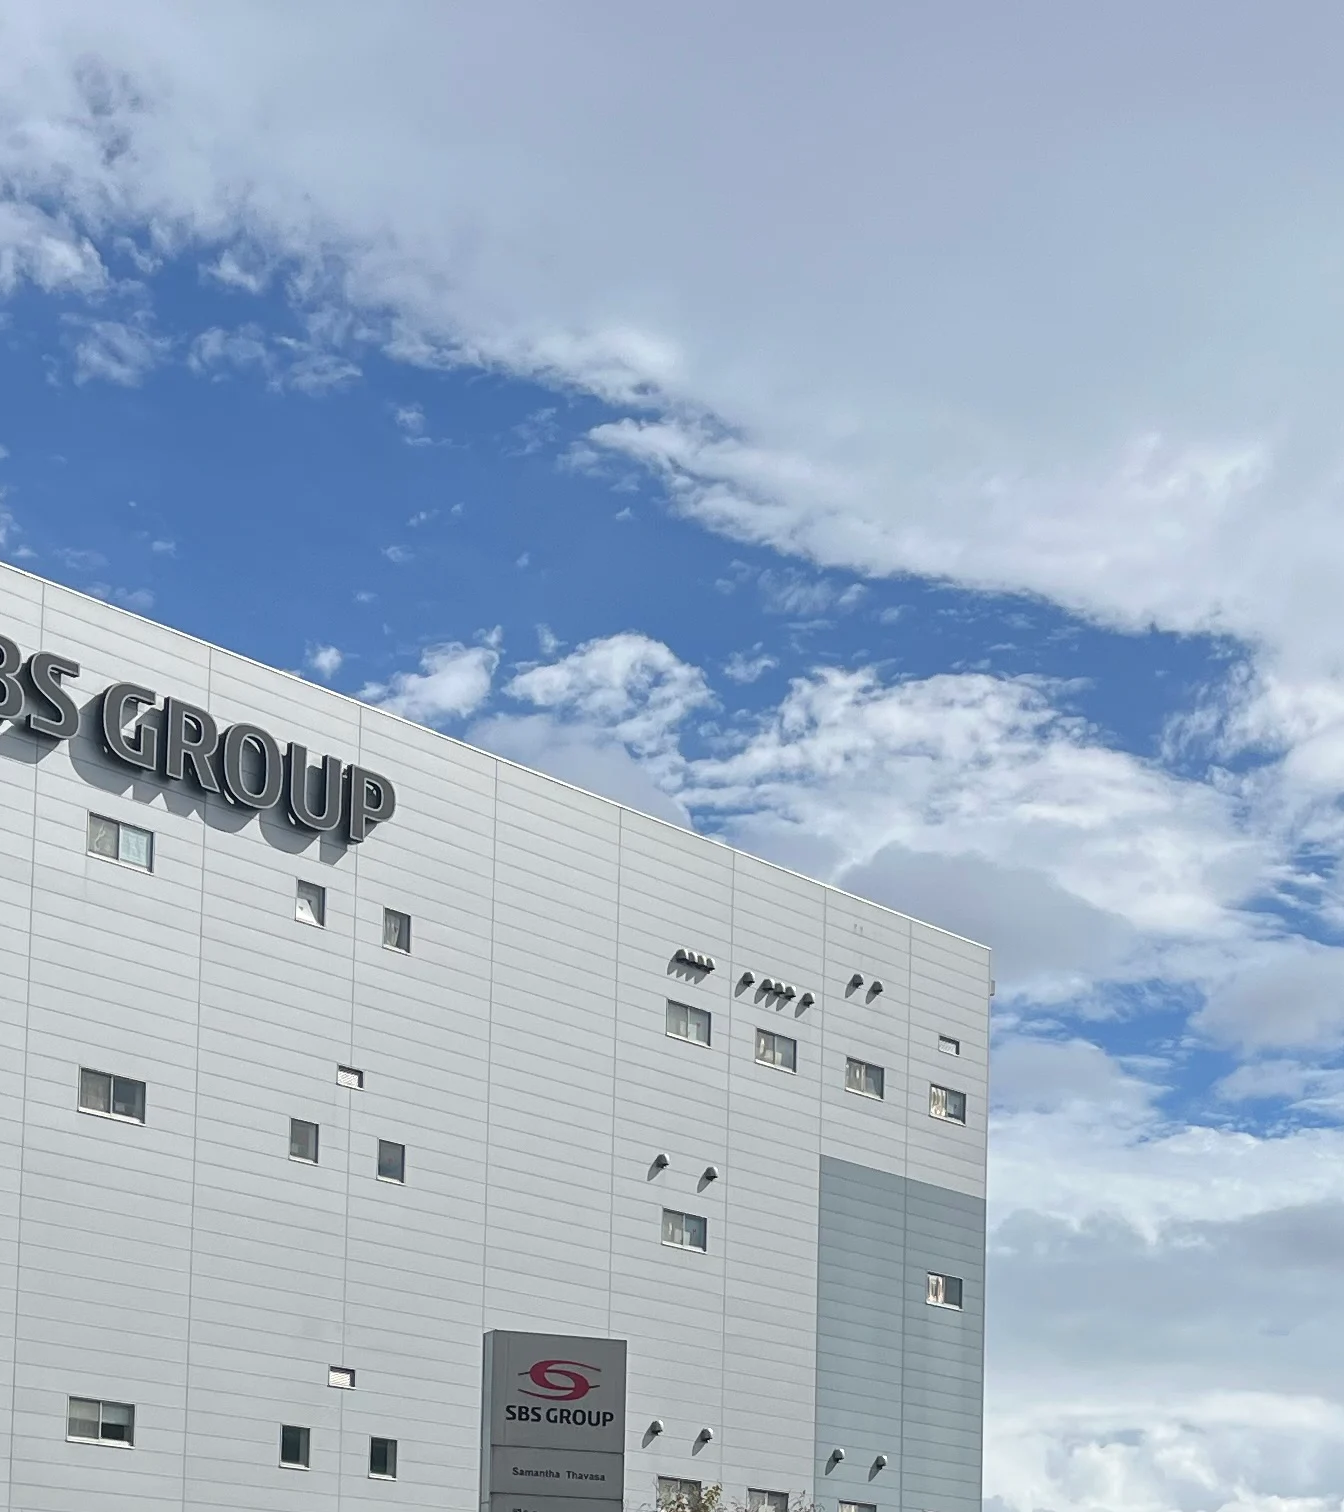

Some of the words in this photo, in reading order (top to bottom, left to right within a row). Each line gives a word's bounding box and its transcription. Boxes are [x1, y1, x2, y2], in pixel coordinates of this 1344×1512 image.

[102, 680, 397, 844] GROUP
[505, 1404, 542, 1424] SBS
[545, 1406, 615, 1428] GROUP
[512, 1466, 561, 1479] Samantha
[565, 1470, 606, 1482] Thavasa
